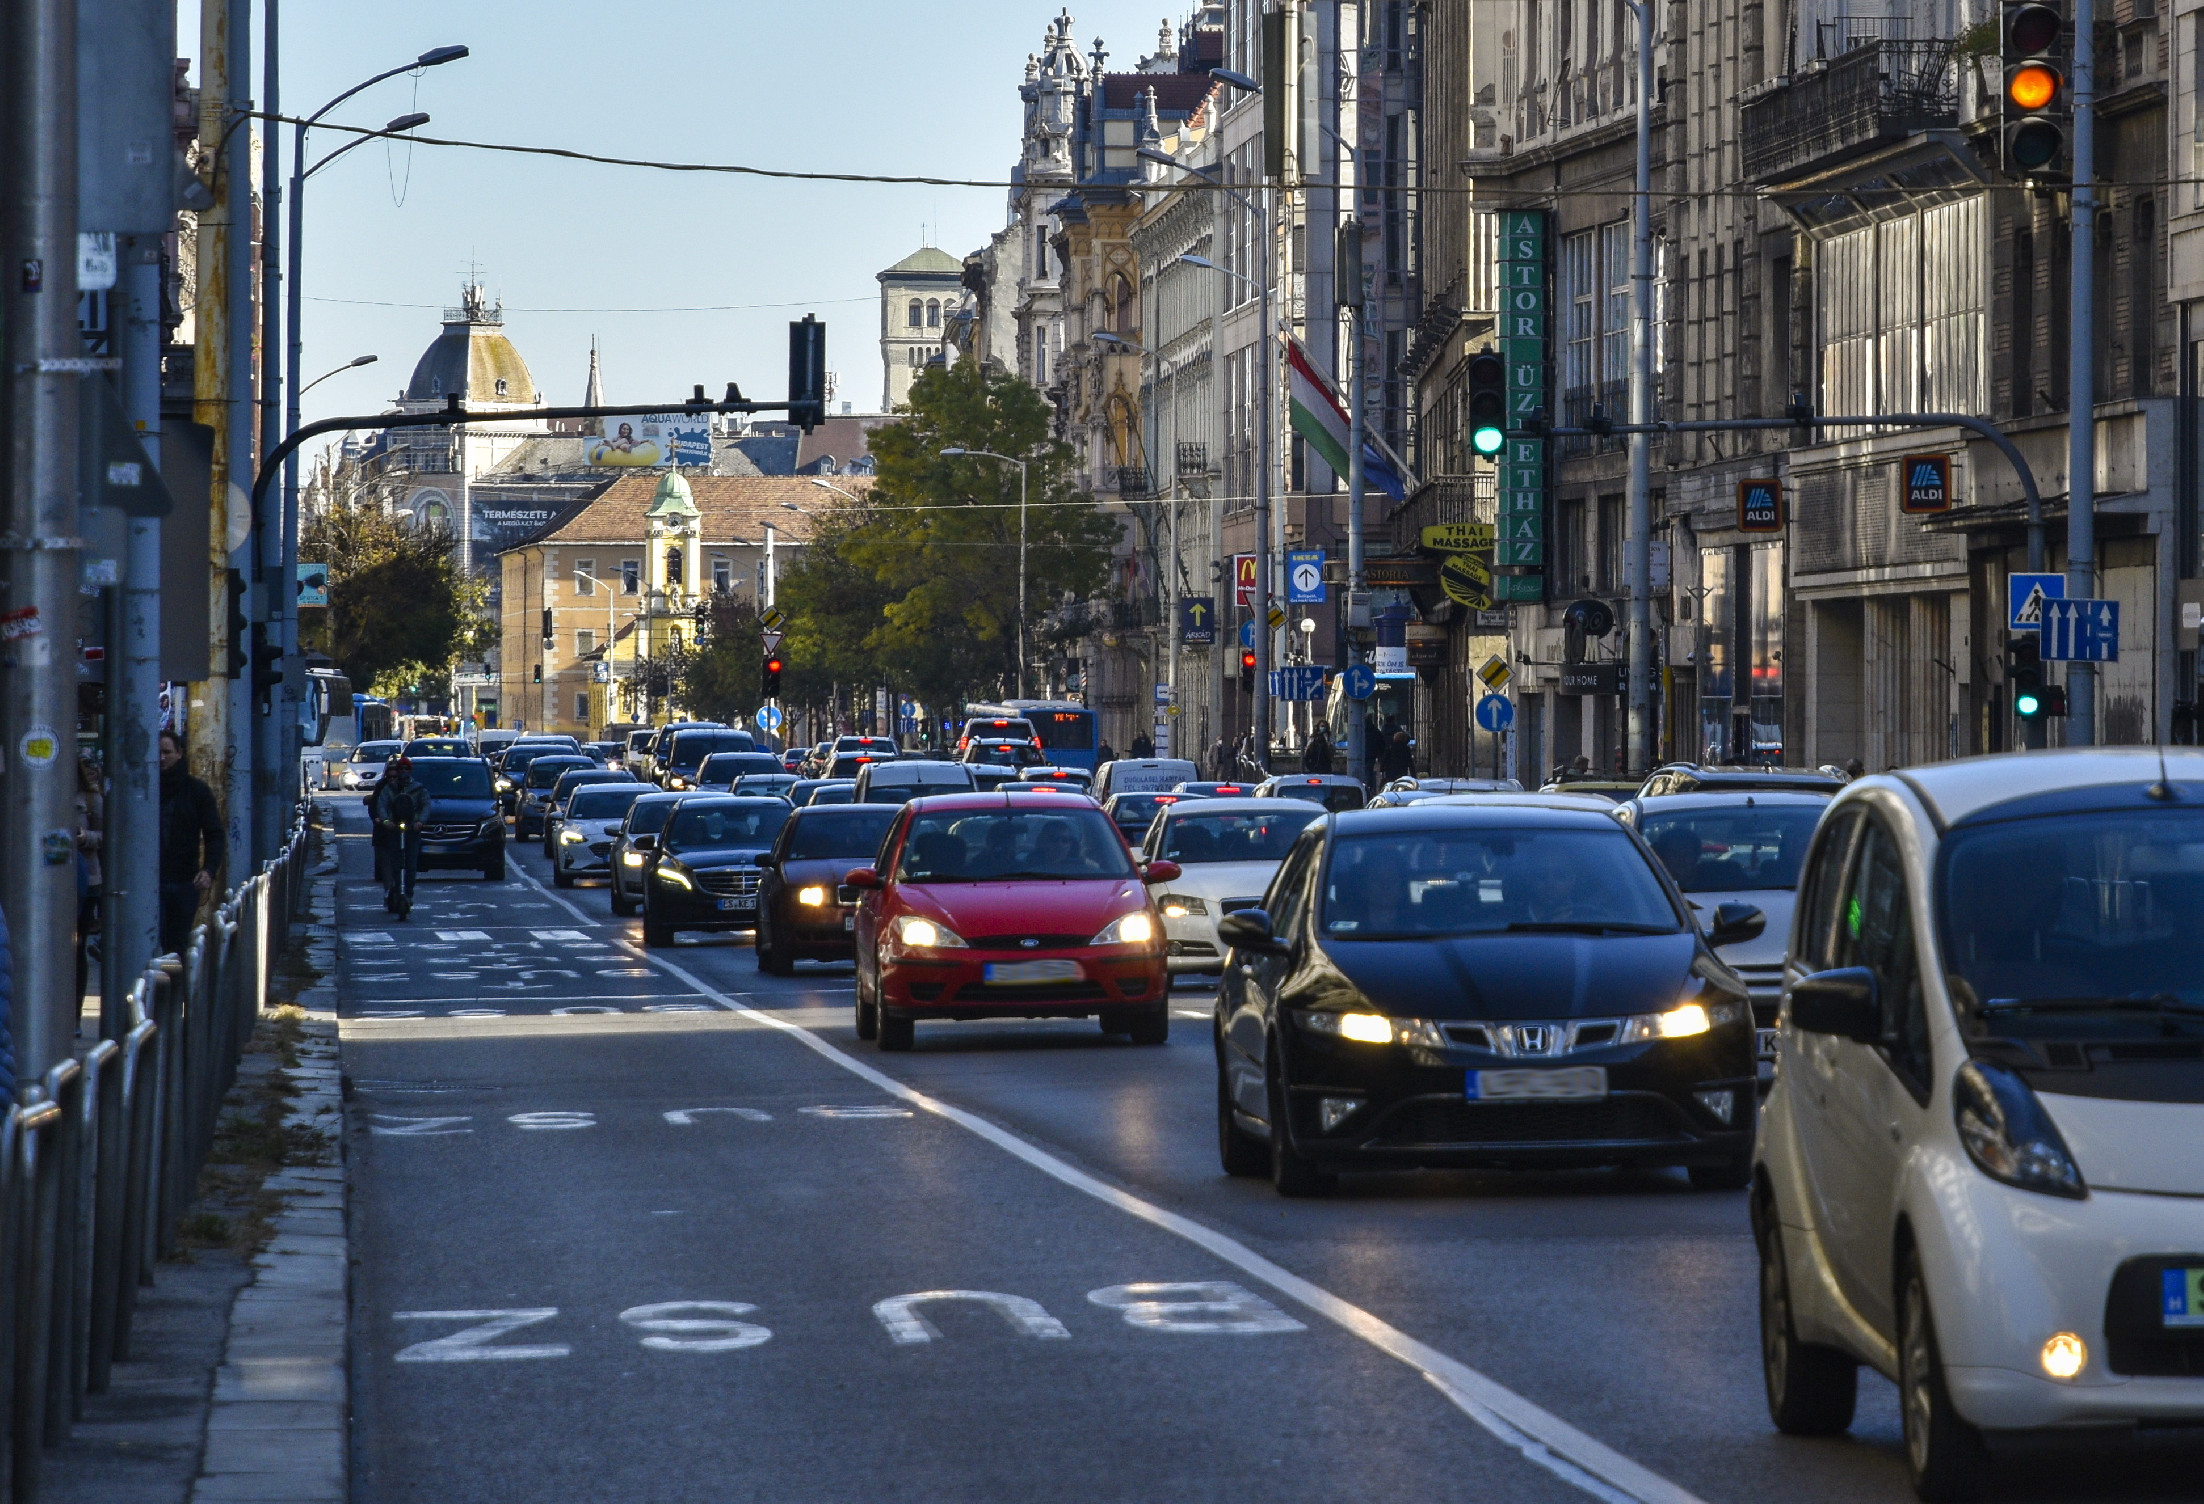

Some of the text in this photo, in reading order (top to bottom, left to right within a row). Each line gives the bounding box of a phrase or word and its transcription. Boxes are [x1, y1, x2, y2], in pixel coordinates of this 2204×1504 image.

[1515, 215, 1537, 336] ASTOR
[641, 413, 709, 424] AQUAWORLD
[1515, 364, 1537, 561] ÜZETHÁZ
[1911, 488, 1943, 501] ALDI
[1746, 510, 1776, 522] ALDI
[1445, 526, 1484, 537] THAI
[1432, 538, 1495, 549] MASSAGE
[1576, 675, 1598, 686] HOME
[392, 1280, 1309, 1364] BUSZ
